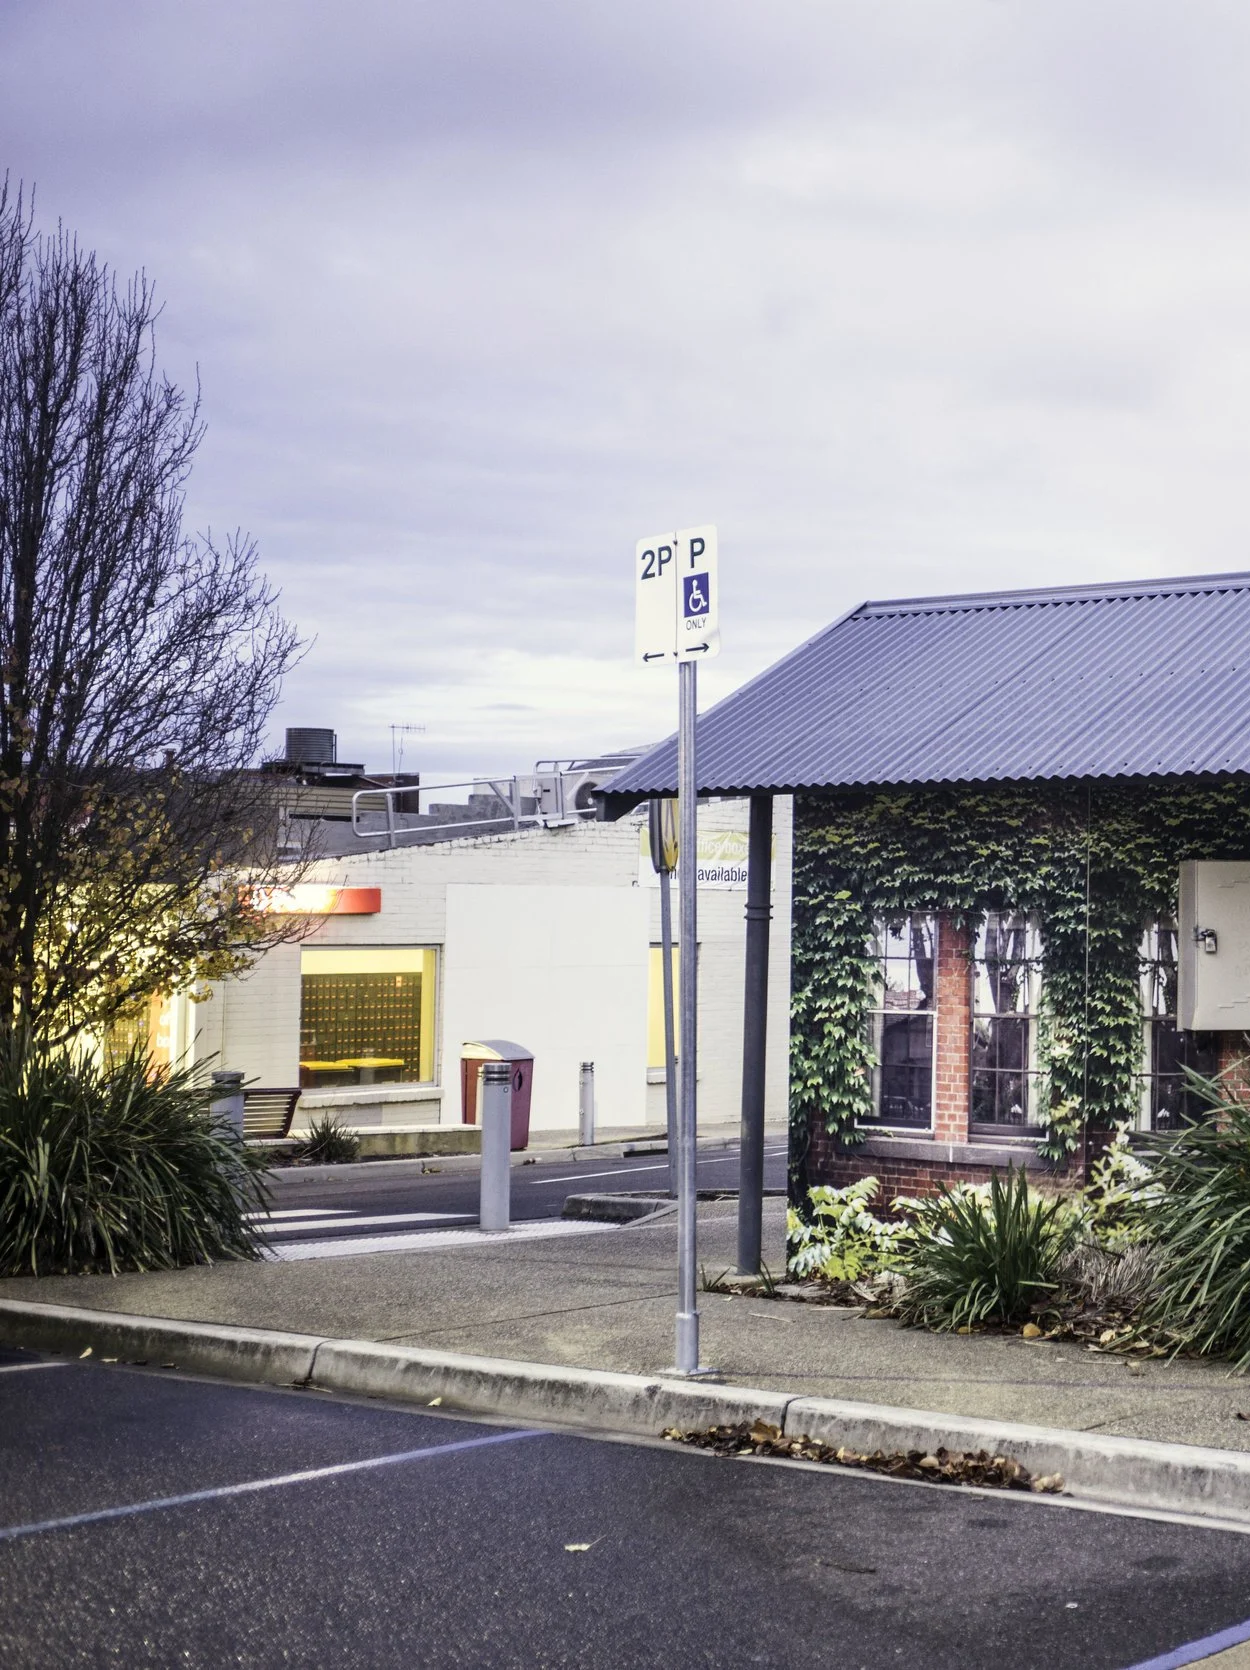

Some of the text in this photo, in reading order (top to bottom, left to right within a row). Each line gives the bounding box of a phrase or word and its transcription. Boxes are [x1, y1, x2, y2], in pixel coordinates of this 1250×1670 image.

[641, 545, 672, 580] 2P
[690, 537, 705, 568] P
[686, 618, 706, 630] ONLY
[697, 866, 748, 882] available
